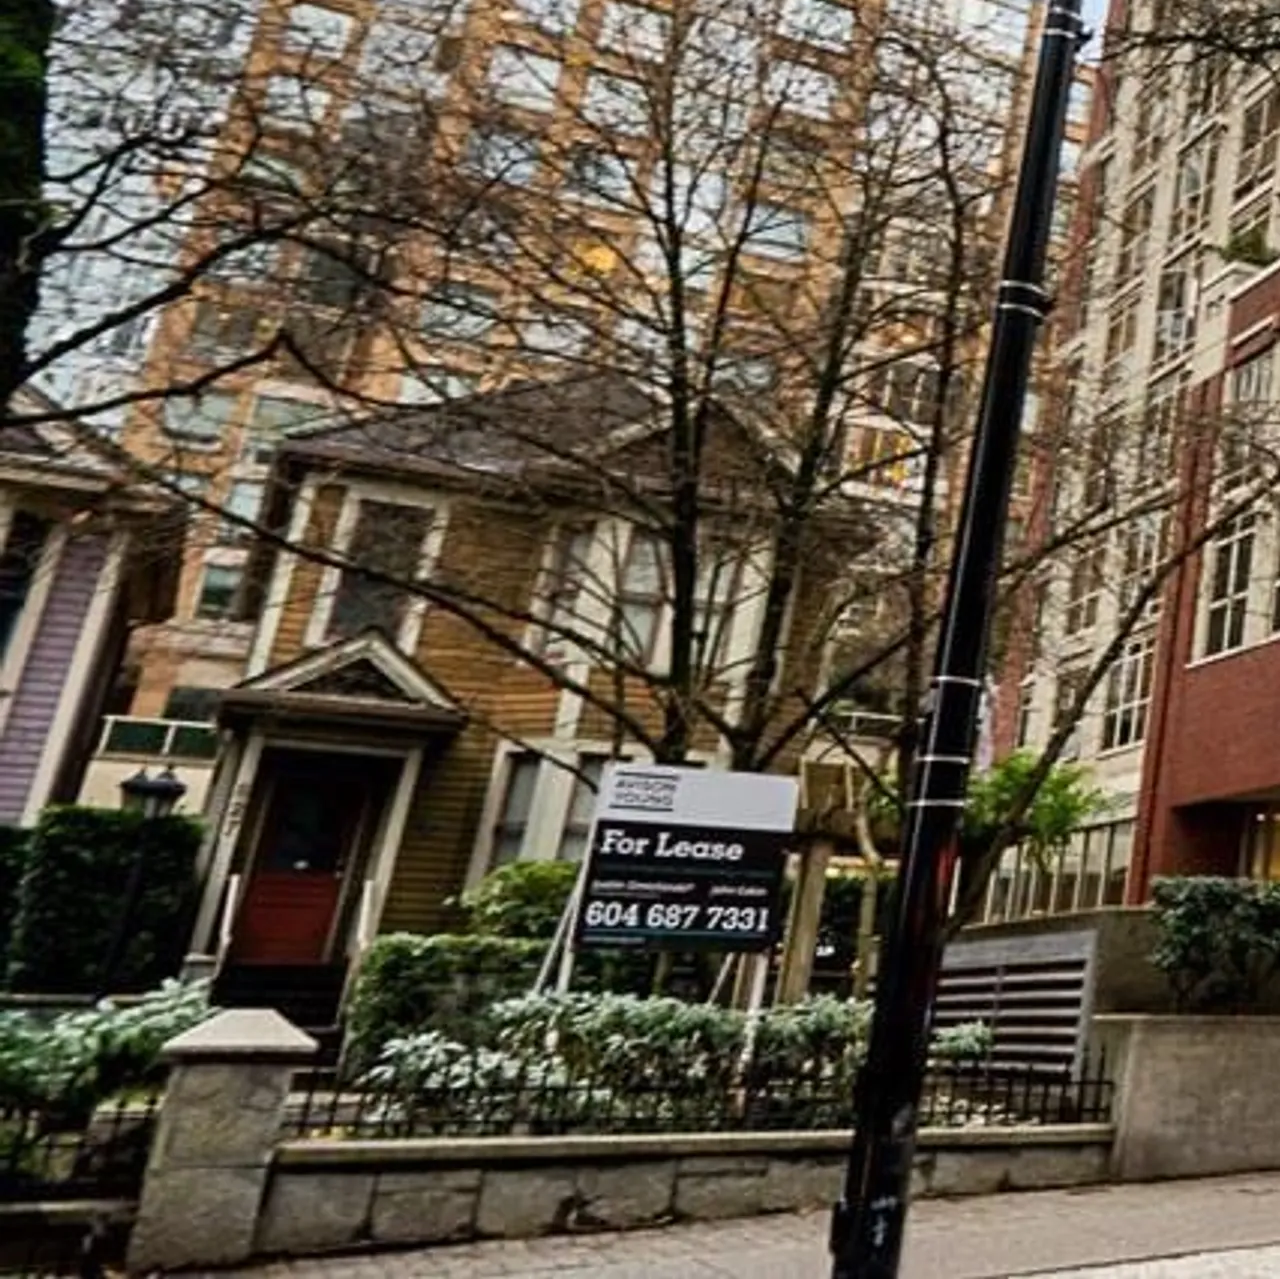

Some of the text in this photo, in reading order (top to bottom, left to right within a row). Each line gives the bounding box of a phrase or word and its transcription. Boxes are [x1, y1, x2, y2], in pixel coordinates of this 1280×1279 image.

[600, 828, 744, 861] For Lease
[585, 901, 769, 932] 604 687 7331
